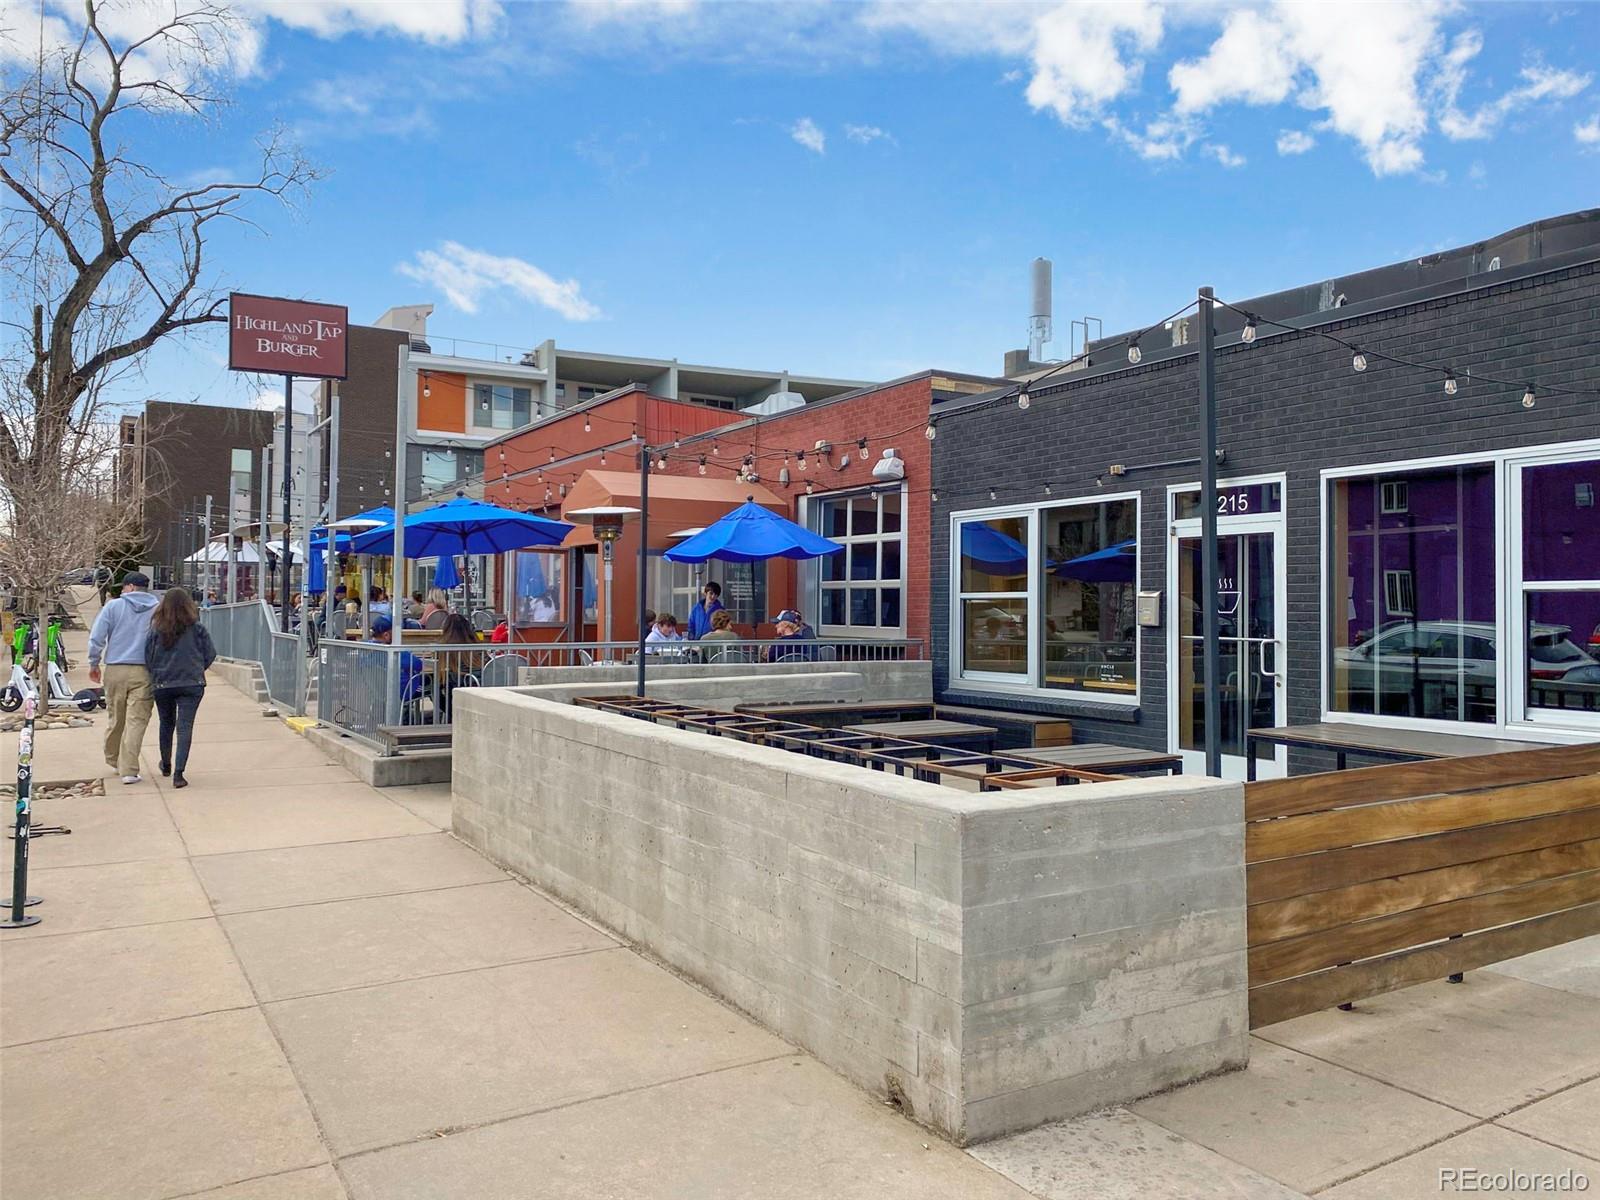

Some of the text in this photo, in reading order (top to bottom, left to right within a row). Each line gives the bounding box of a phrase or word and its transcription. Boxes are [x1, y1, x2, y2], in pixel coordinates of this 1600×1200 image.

[236, 315, 342, 341] HIGHLAND TAP
[256, 338, 323, 359] BURGER
[1217, 494, 1248, 513] 215
